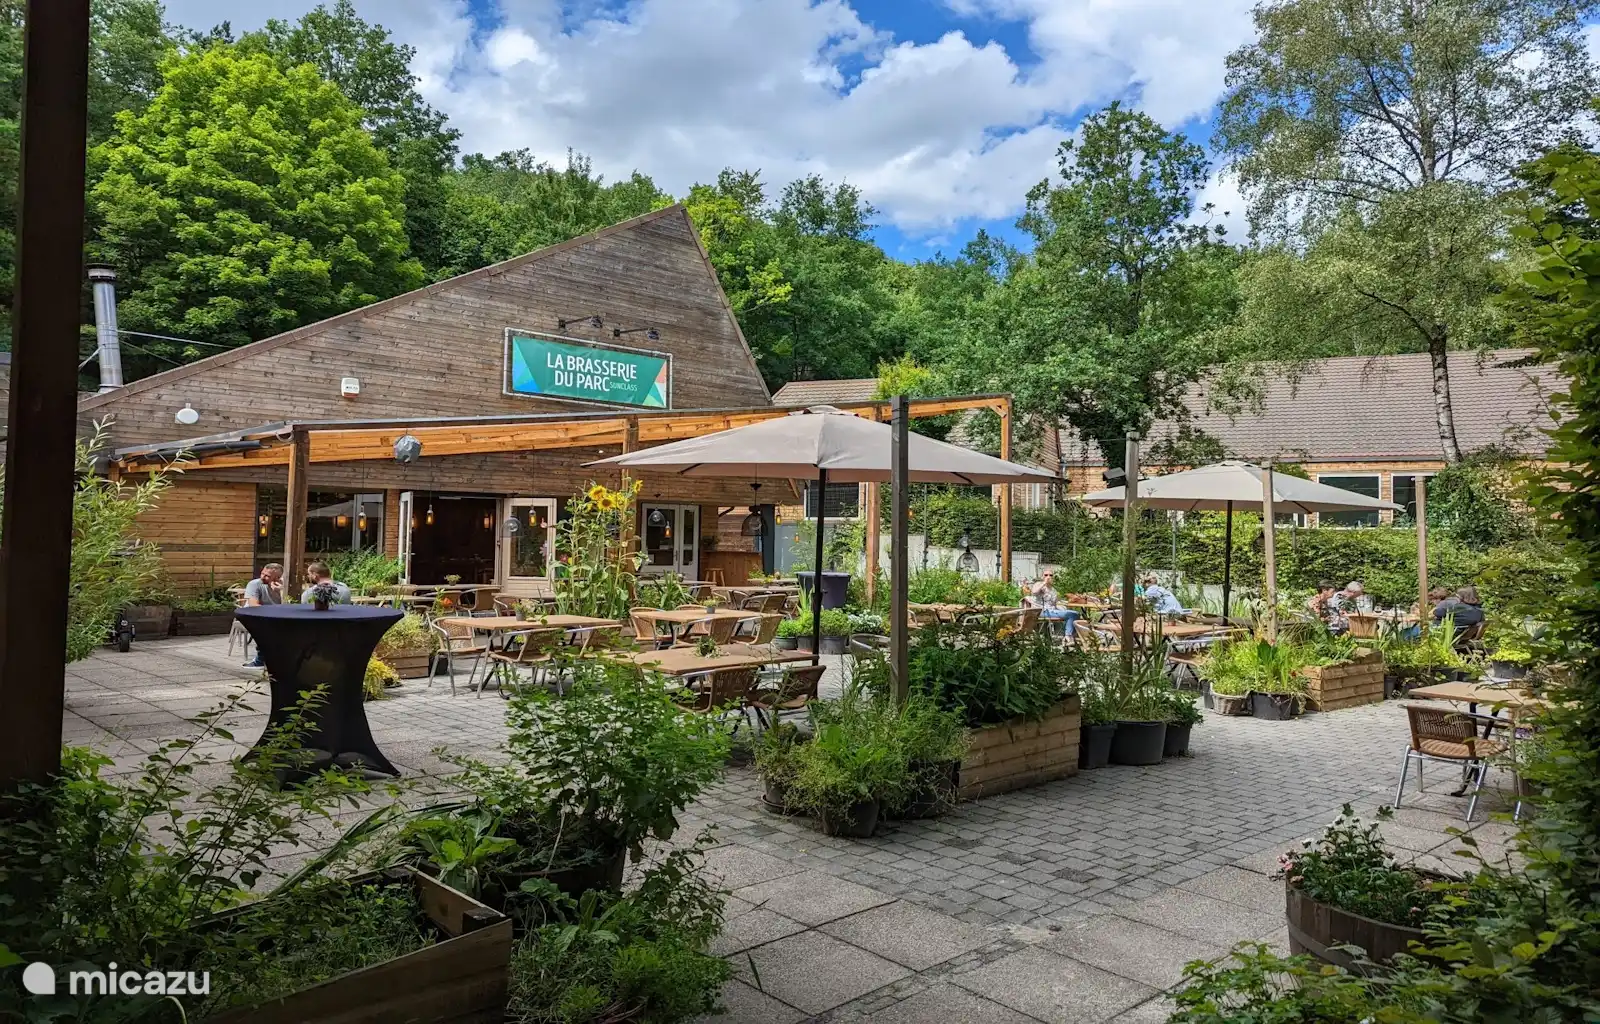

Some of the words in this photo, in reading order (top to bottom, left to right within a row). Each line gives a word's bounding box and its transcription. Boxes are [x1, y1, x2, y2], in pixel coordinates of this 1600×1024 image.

[547, 352, 564, 369] LA
[567, 355, 637, 382] BRASSERIE
[554, 370, 573, 387] DU
[577, 373, 610, 392] PARC
[610, 381, 638, 392] SUNCLASS
